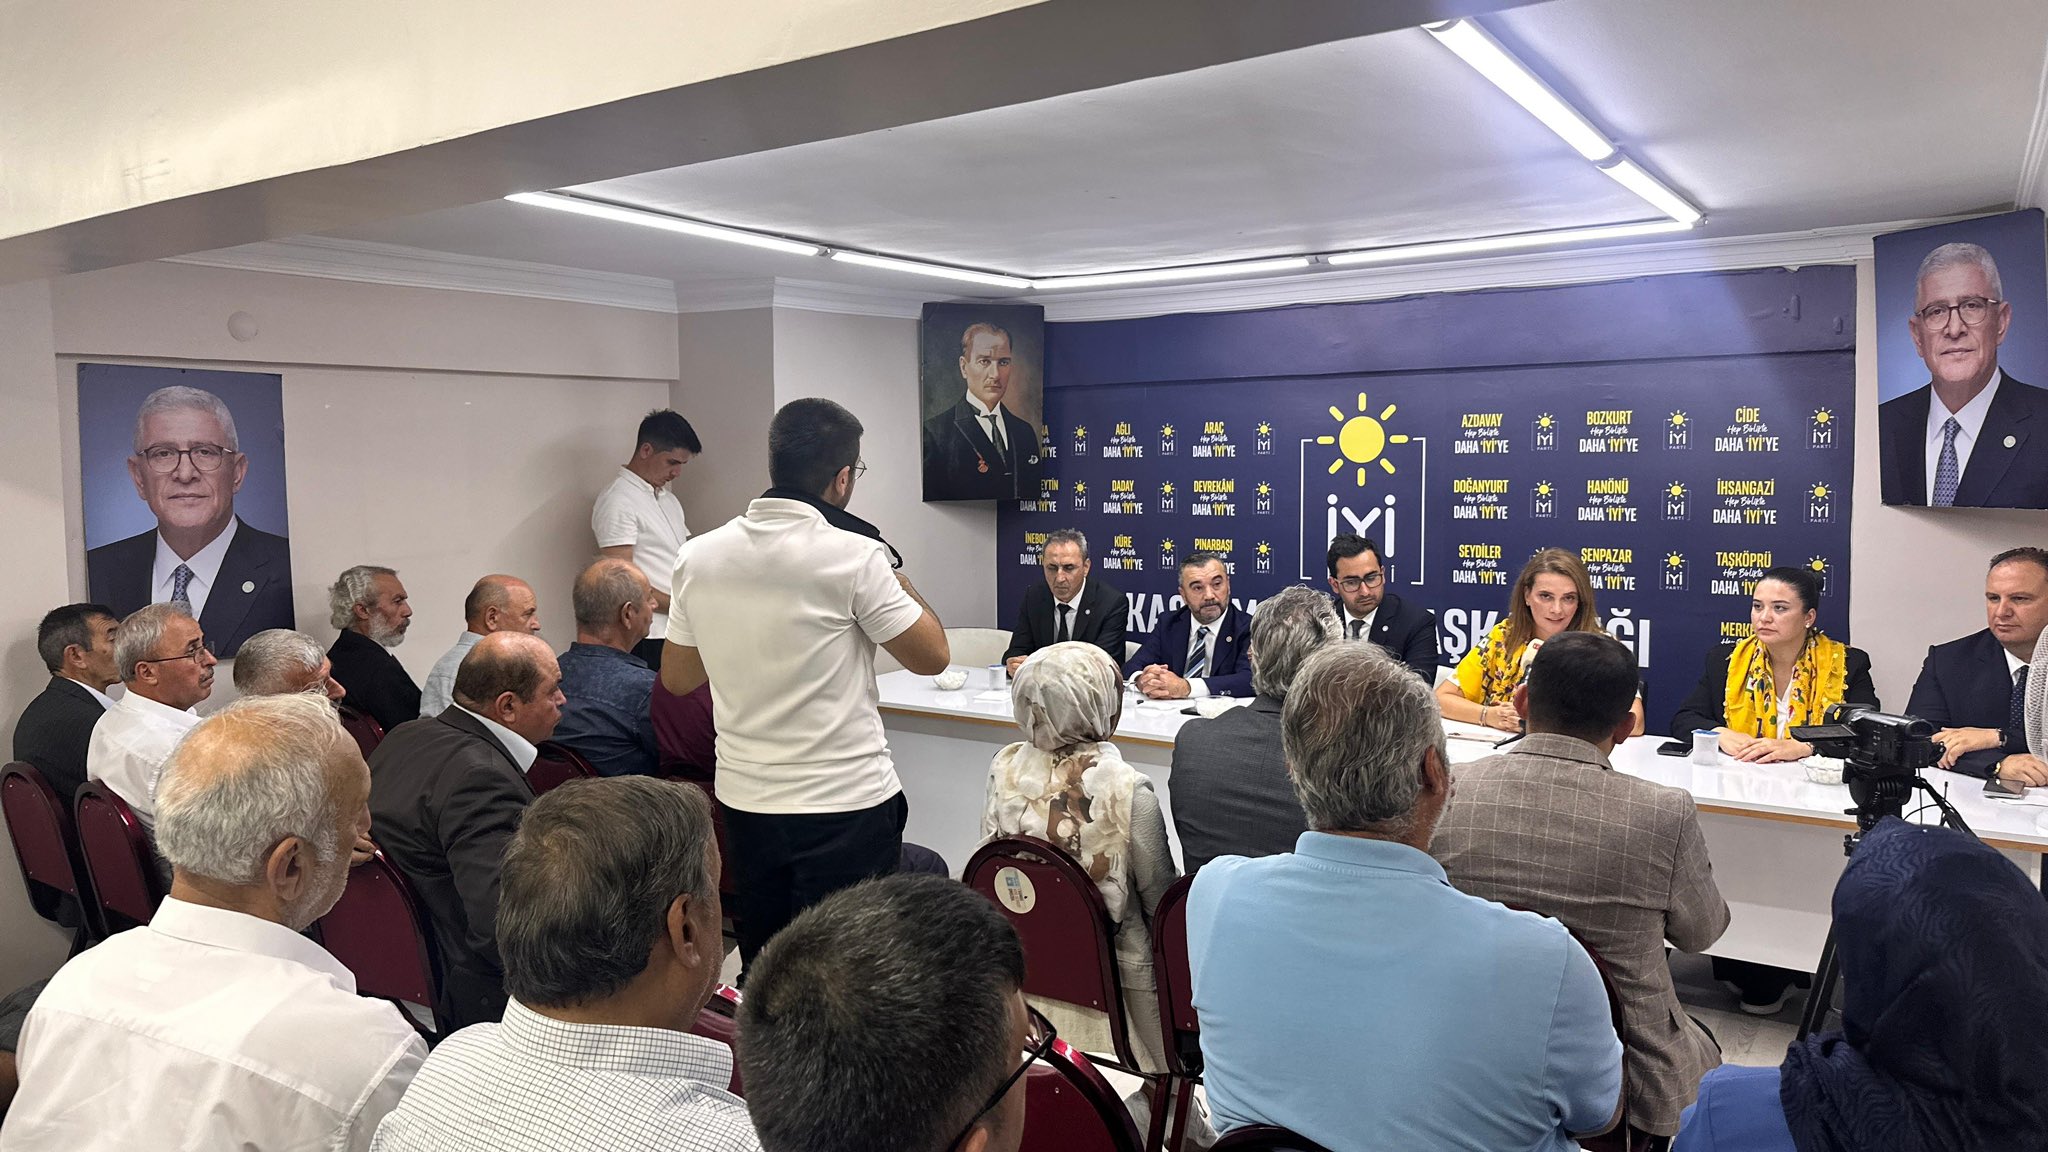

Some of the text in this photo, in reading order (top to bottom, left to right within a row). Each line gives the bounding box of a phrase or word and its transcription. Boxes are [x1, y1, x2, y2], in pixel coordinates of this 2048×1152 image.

[1462, 414, 1503, 428] AZDAVAY
[1586, 410, 1632, 425] BOZKURT
[1736, 406, 1760, 422] CİDE
[1116, 422, 1130, 435] AĞLI
[1204, 422, 1224, 436] ARAÇ
[1104, 446, 1121, 458] DAHA
[1192, 446, 1212, 457] DAHA
[1454, 440, 1479, 454] DAHA
[1580, 438, 1606, 452] DAHA
[1715, 438, 1744, 452] DAHA
[1112, 480, 1134, 492] DADAY
[1454, 477, 1509, 493] DOĞANYURT
[1587, 478, 1629, 494] HANÖNÜ
[1717, 478, 1774, 496] İHSANGAZİ
[1020, 501, 1036, 512] DAHA
[1104, 502, 1121, 514] DAHA
[1192, 504, 1212, 516] DAHA
[1454, 506, 1478, 518] DAHA
[1578, 507, 1604, 521] DAHA
[1713, 509, 1742, 524] DAHA
[1025, 531, 1048, 544] İNEBOL
[1114, 534, 1132, 548] KÜRE
[1194, 538, 1232, 553] PINARBAŞI
[1459, 543, 1502, 558] SEYDİLER
[1020, 554, 1036, 566] DAHA
[1581, 548, 1632, 564] ŞENPAZAR
[1716, 550, 1772, 568] TAŞKÖPRÜ
[1104, 558, 1121, 570] DAHA
[1453, 570, 1478, 584] DAHA
[1712, 580, 1740, 595] DAHA
